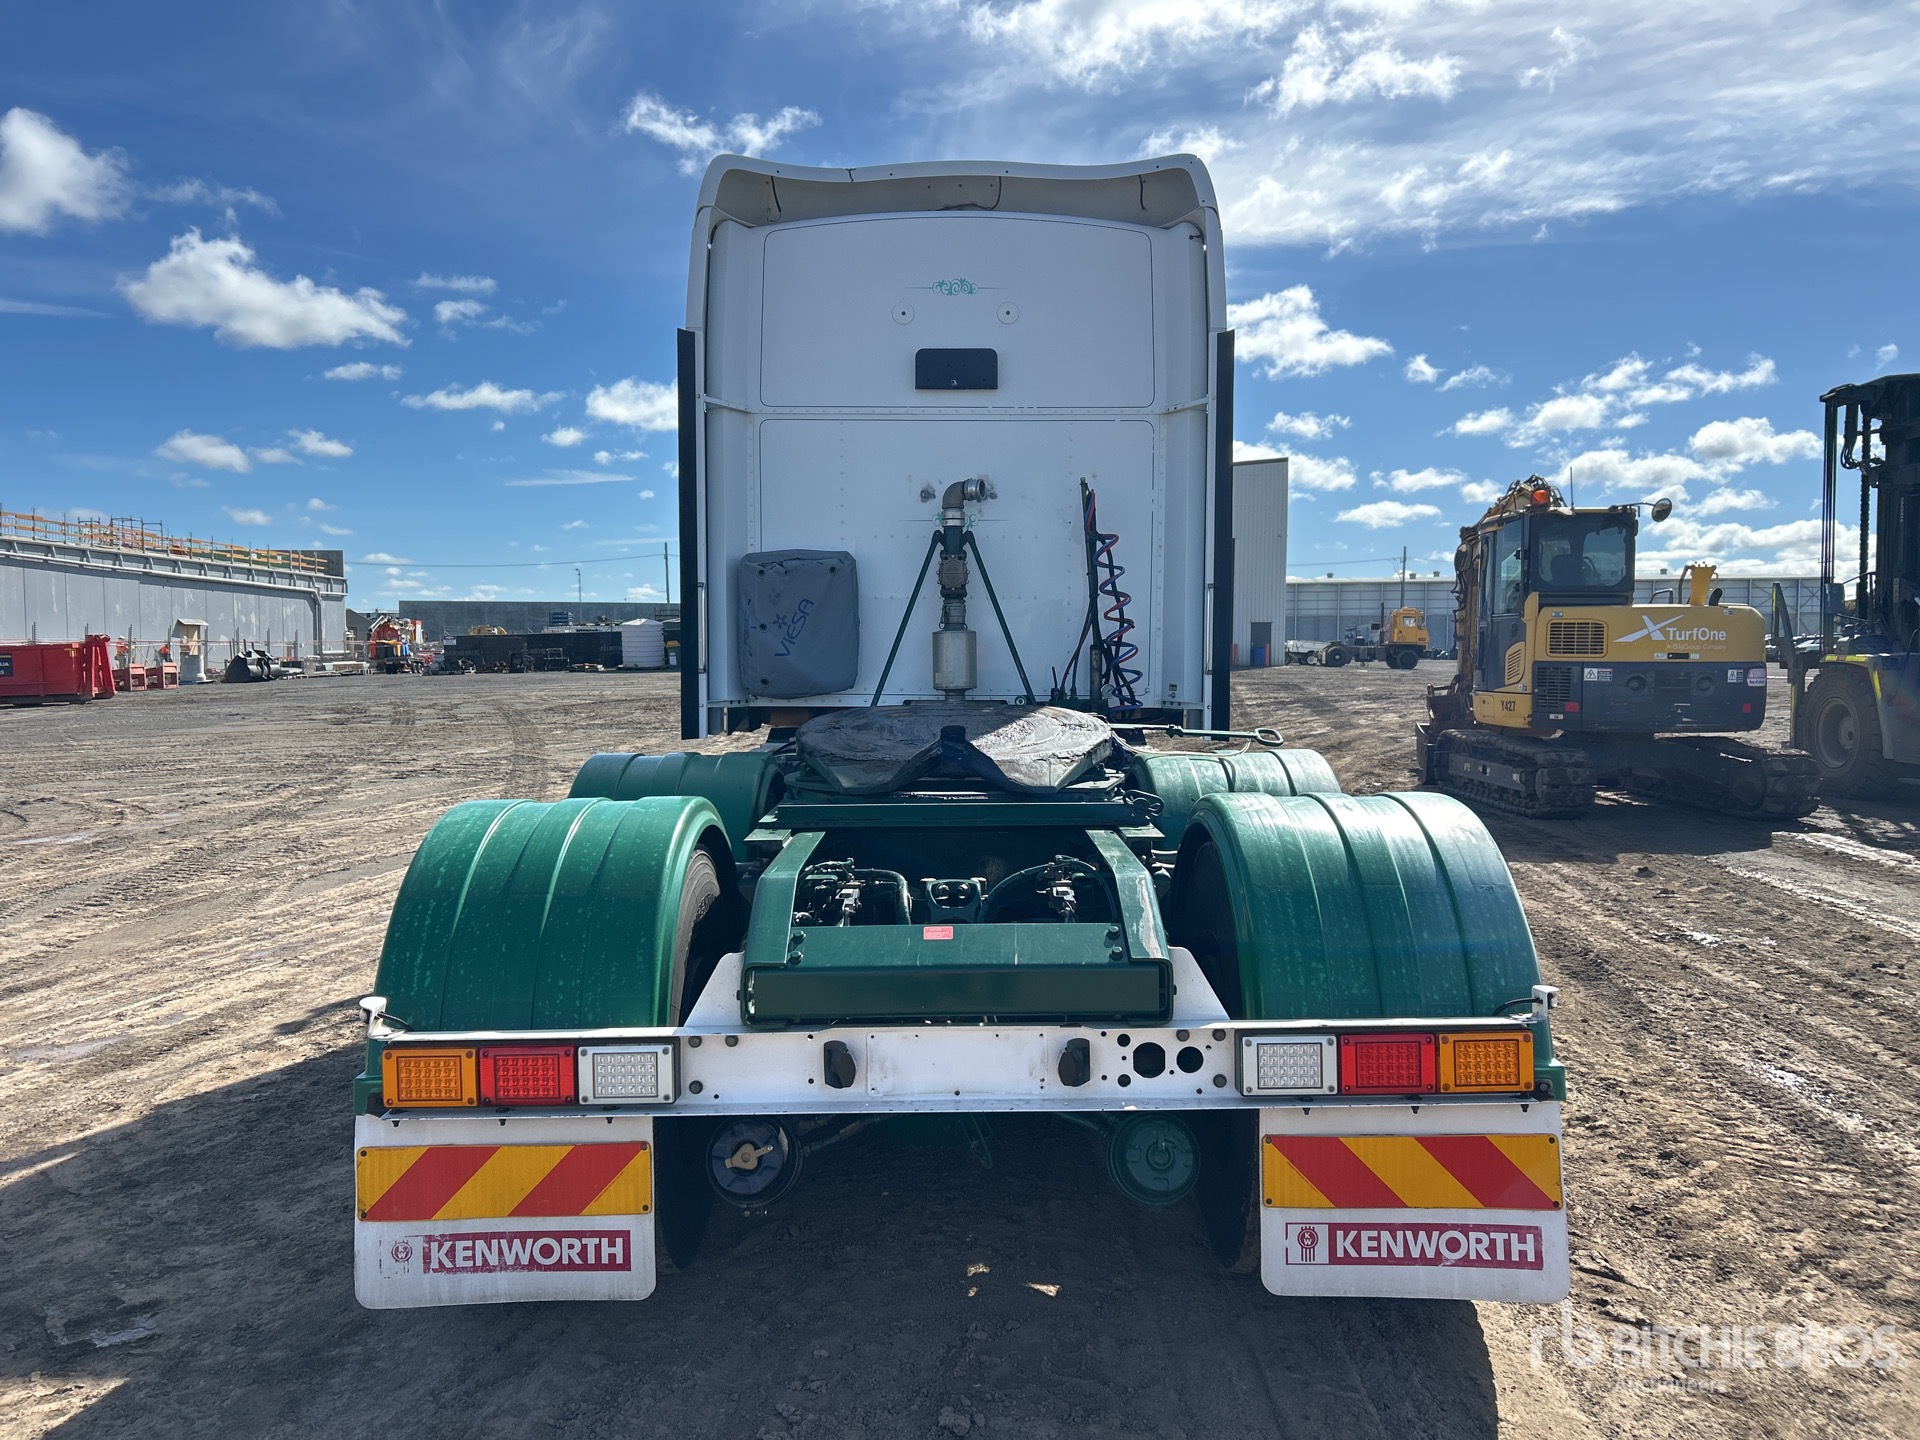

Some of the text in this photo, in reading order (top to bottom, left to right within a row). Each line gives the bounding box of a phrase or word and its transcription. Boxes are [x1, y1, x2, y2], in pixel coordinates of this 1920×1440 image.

[774, 598, 815, 657] VIESA
[1665, 627, 1727, 641] TurfOne
[1500, 700, 1516, 712] Y427
[430, 1237, 624, 1269] KENWORTH
[1336, 1230, 1536, 1262] KENWORTH
